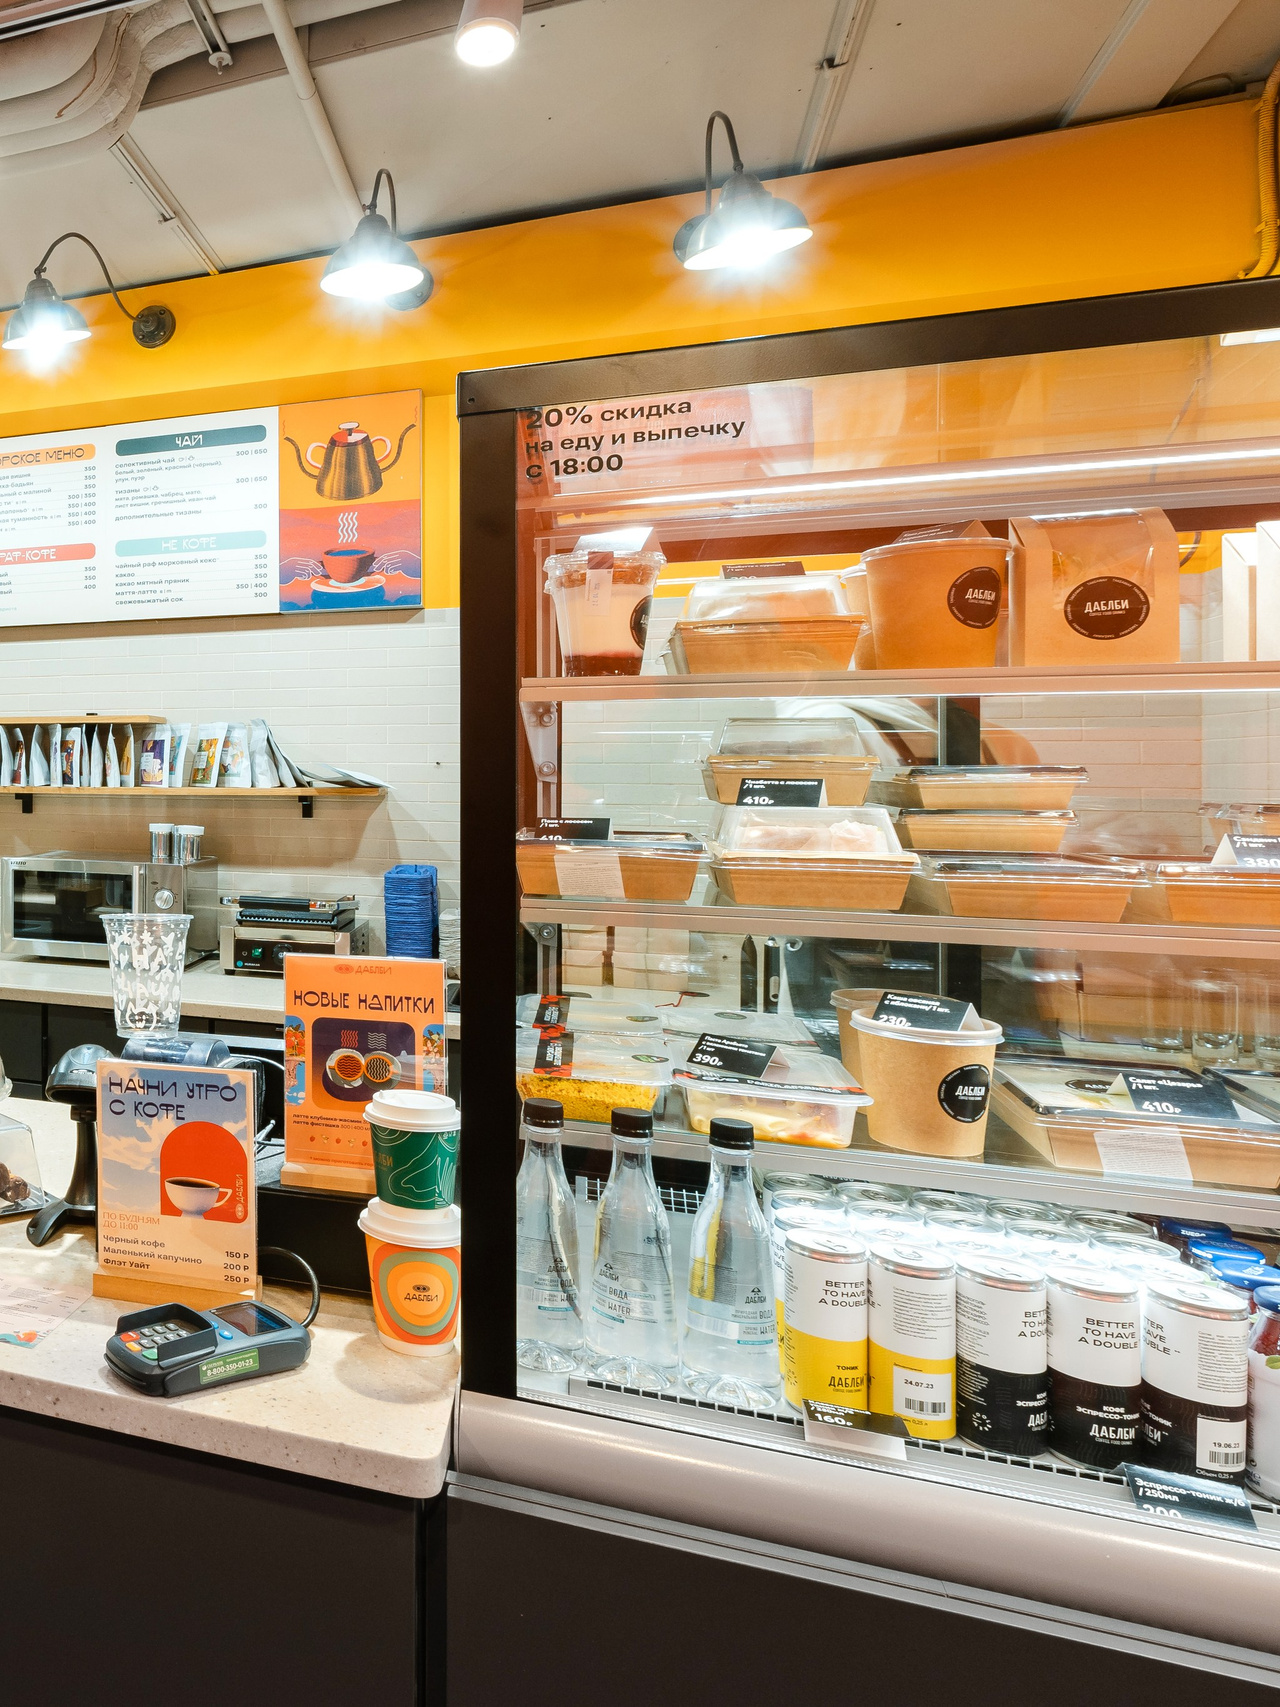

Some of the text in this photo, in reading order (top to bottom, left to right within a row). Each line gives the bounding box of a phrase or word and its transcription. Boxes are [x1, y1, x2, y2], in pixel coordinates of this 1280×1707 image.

[526, 401, 692, 430] 20% скидка
[175, 434, 203, 447] ЧАЙ
[526, 420, 746, 453] на еду и выпечку
[46, 448, 84, 461] МЕНЮ
[115, 459, 161, 468] селективный
[526, 454, 623, 479] с 18:00
[23, 488, 52, 496] малиной
[10, 515, 48, 524] туманность
[115, 512, 173, 521] дополнительные
[162, 537, 216, 551] НЕ КОФЕ
[158, 558, 198, 566] морковный
[965, 588, 996, 601] ДАБЛБИ
[115, 597, 169, 605] свежевыжатый
[1084, 600, 1129, 613] ДАБЛБИ
[355, 965, 391, 975] ДАБЛБИ
[294, 990, 434, 1014] НОВЫЕ НАПИТКИ
[109, 1077, 237, 1102] НАЧНИ УТРО
[955, 1086, 985, 1096] ДАБЛБИ
[109, 1099, 185, 1120] С КОФЕ
[310, 1115, 362, 1124] клубника-жасмин
[236, 1174, 245, 1203] ДАБЛБИ
[103, 1212, 160, 1225] ПО БУДНЯМ
[103, 1220, 138, 1230] ДО 11:00
[103, 1235, 165, 1248] Черный кофе
[103, 1247, 202, 1264] Маленький капучино
[225, 1251, 240, 1259] 150
[104, 1258, 150, 1269] Флэт Уайт
[599, 1269, 619, 1281] ДАБЛБИ
[826, 1280, 864, 1288] BETTER
[404, 1293, 438, 1301] ДАБЛБИ
[609, 1287, 628, 1299] ВОДА
[823, 1289, 838, 1297] TO
[745, 1296, 766, 1304] ДАБЛБИ
[832, 1299, 867, 1307] DOUBLE
[608, 1302, 630, 1315] WATER
[760, 1310, 773, 1319] ВОДА
[1086, 1318, 1134, 1329] BETTER
[1083, 1327, 1101, 1336] TO
[1093, 1340, 1138, 1349] DOUBLE
[207, 1359, 253, 1377] 8-800-350-01-23
[828, 1376, 864, 1388] ДАБЛБИ
[904, 1379, 933, 1389] 24.07.23
[1089, 1424, 1135, 1439] ДАБЛБИ
[1196, 1469, 1217, 1478] Объем
[1135, 1478, 1245, 1507] Эспрессо-тоник ж/б
